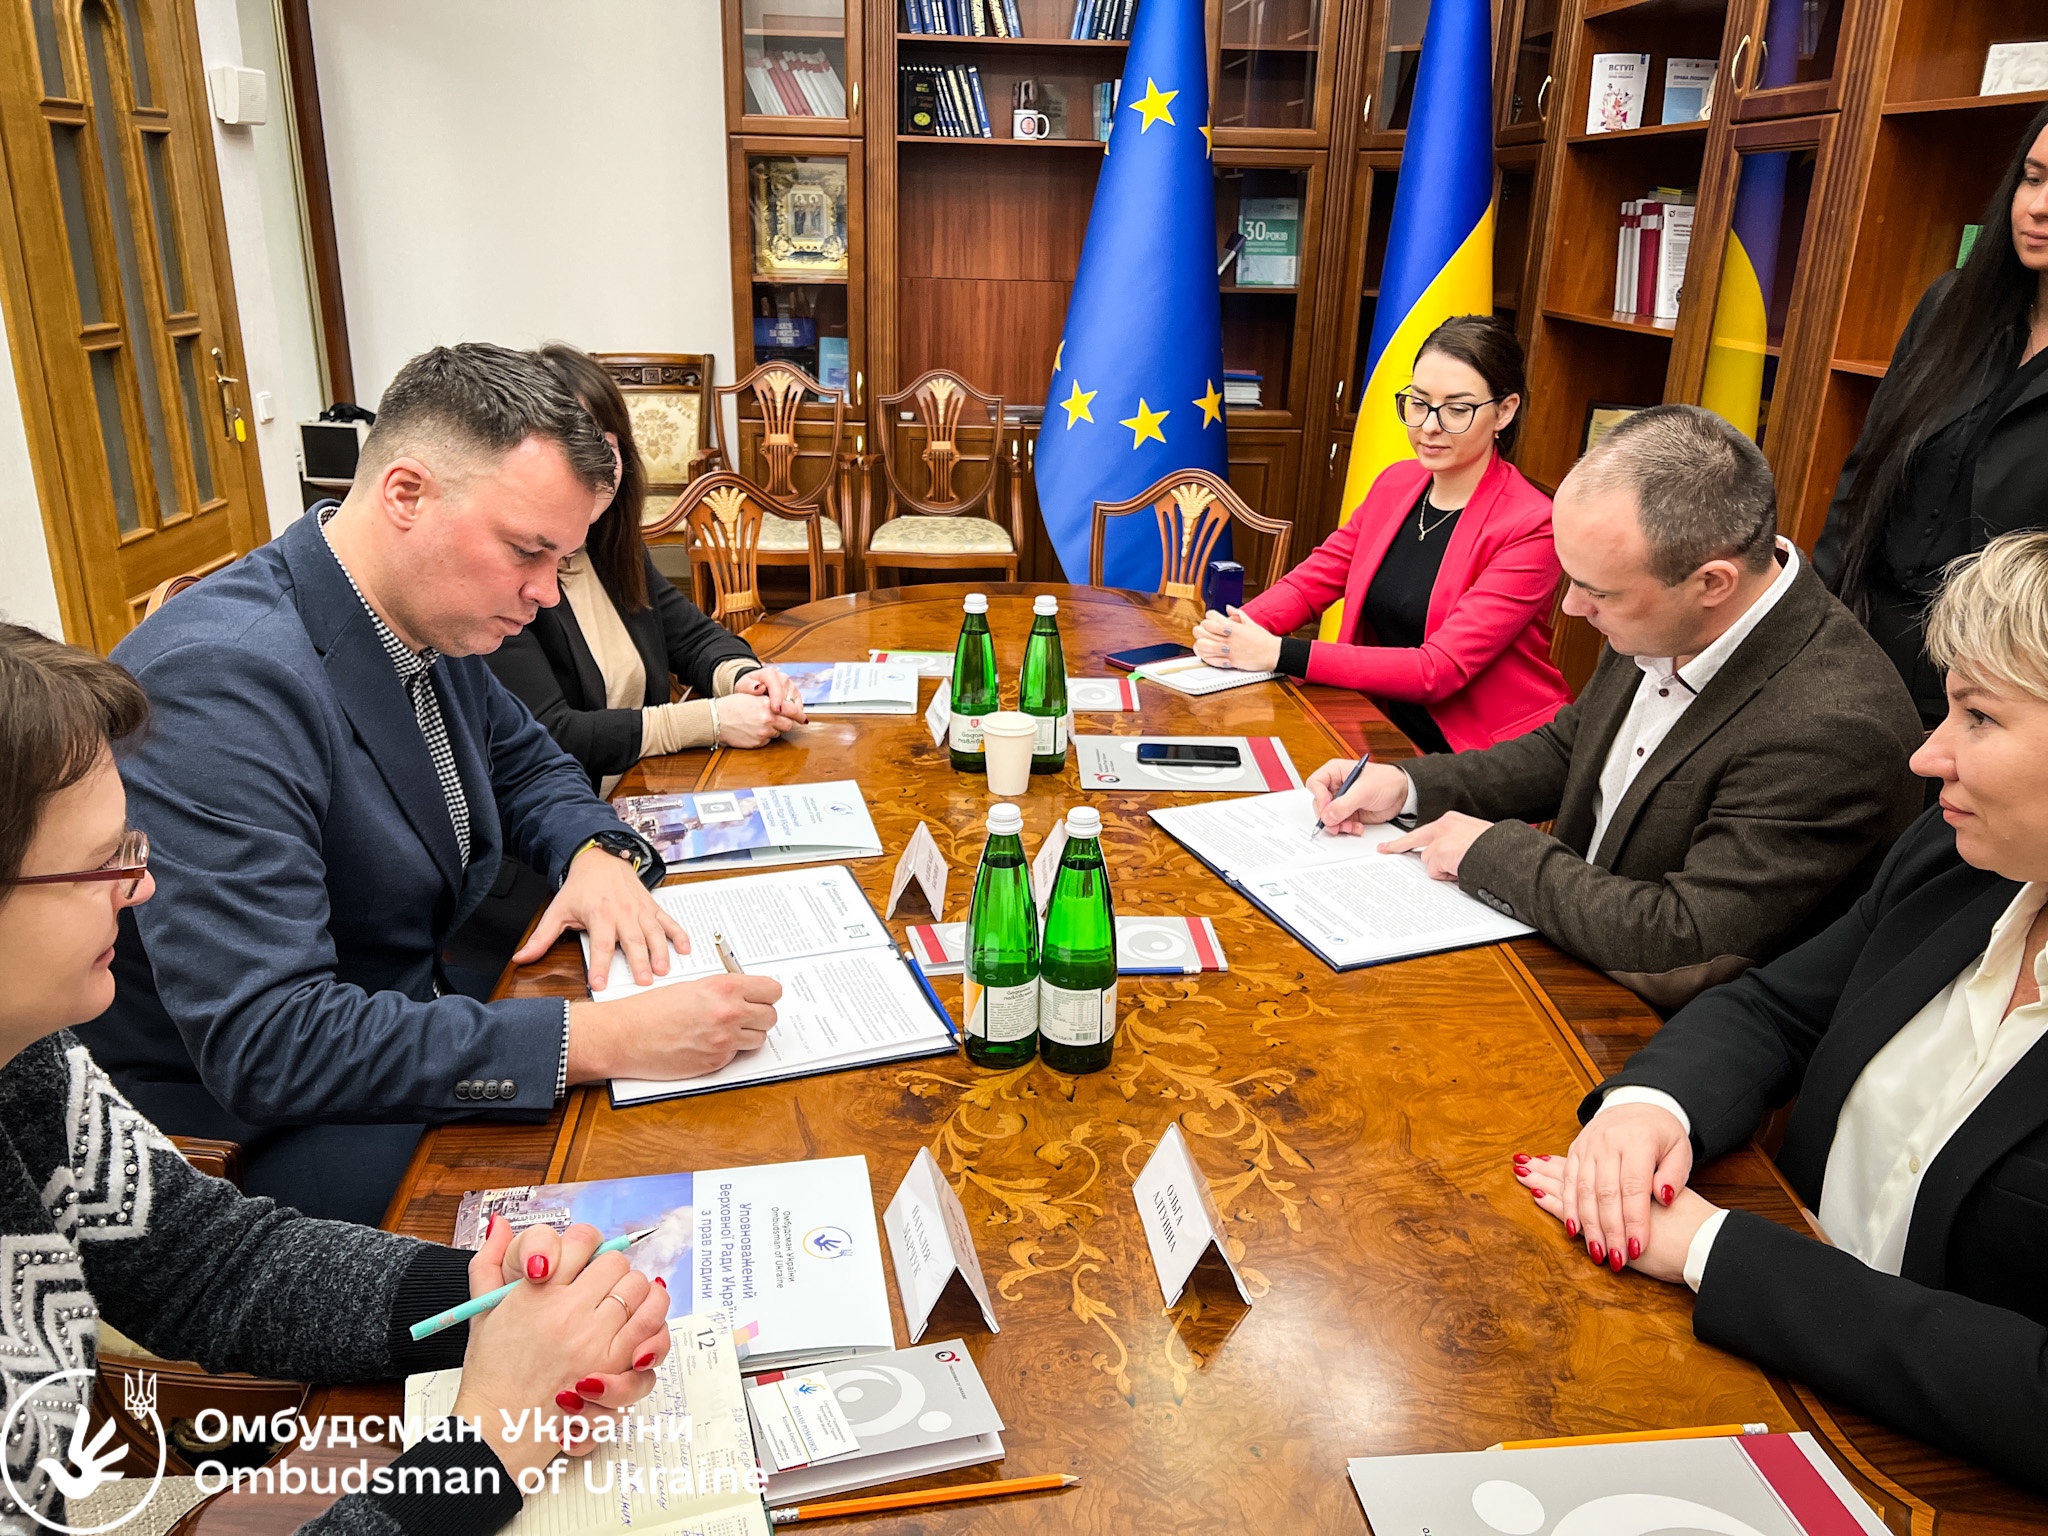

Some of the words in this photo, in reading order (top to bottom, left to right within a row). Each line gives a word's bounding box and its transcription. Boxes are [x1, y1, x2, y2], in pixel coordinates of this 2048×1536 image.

[1245, 221, 1266, 240] 30
[717, 1183, 735, 1240] Верховної
[1153, 1191, 1176, 1253] АЛТУНІНА
[1167, 1184, 1183, 1226] ОЛЬГА
[698, 1219, 712, 1246] прав
[771, 1207, 781, 1249] Ombudsman
[782, 1211, 792, 1251] Омбудсман
[912, 1205, 931, 1262] НАТАЛІЯ
[719, 1243, 734, 1273] Ради
[739, 1202, 757, 1299] Уповноважений
[774, 1251, 783, 1259] of
[785, 1253, 796, 1282] України
[699, 1249, 712, 1299] людини
[775, 1260, 784, 1288] Ukraine
[697, 1328, 716, 1350] 12
